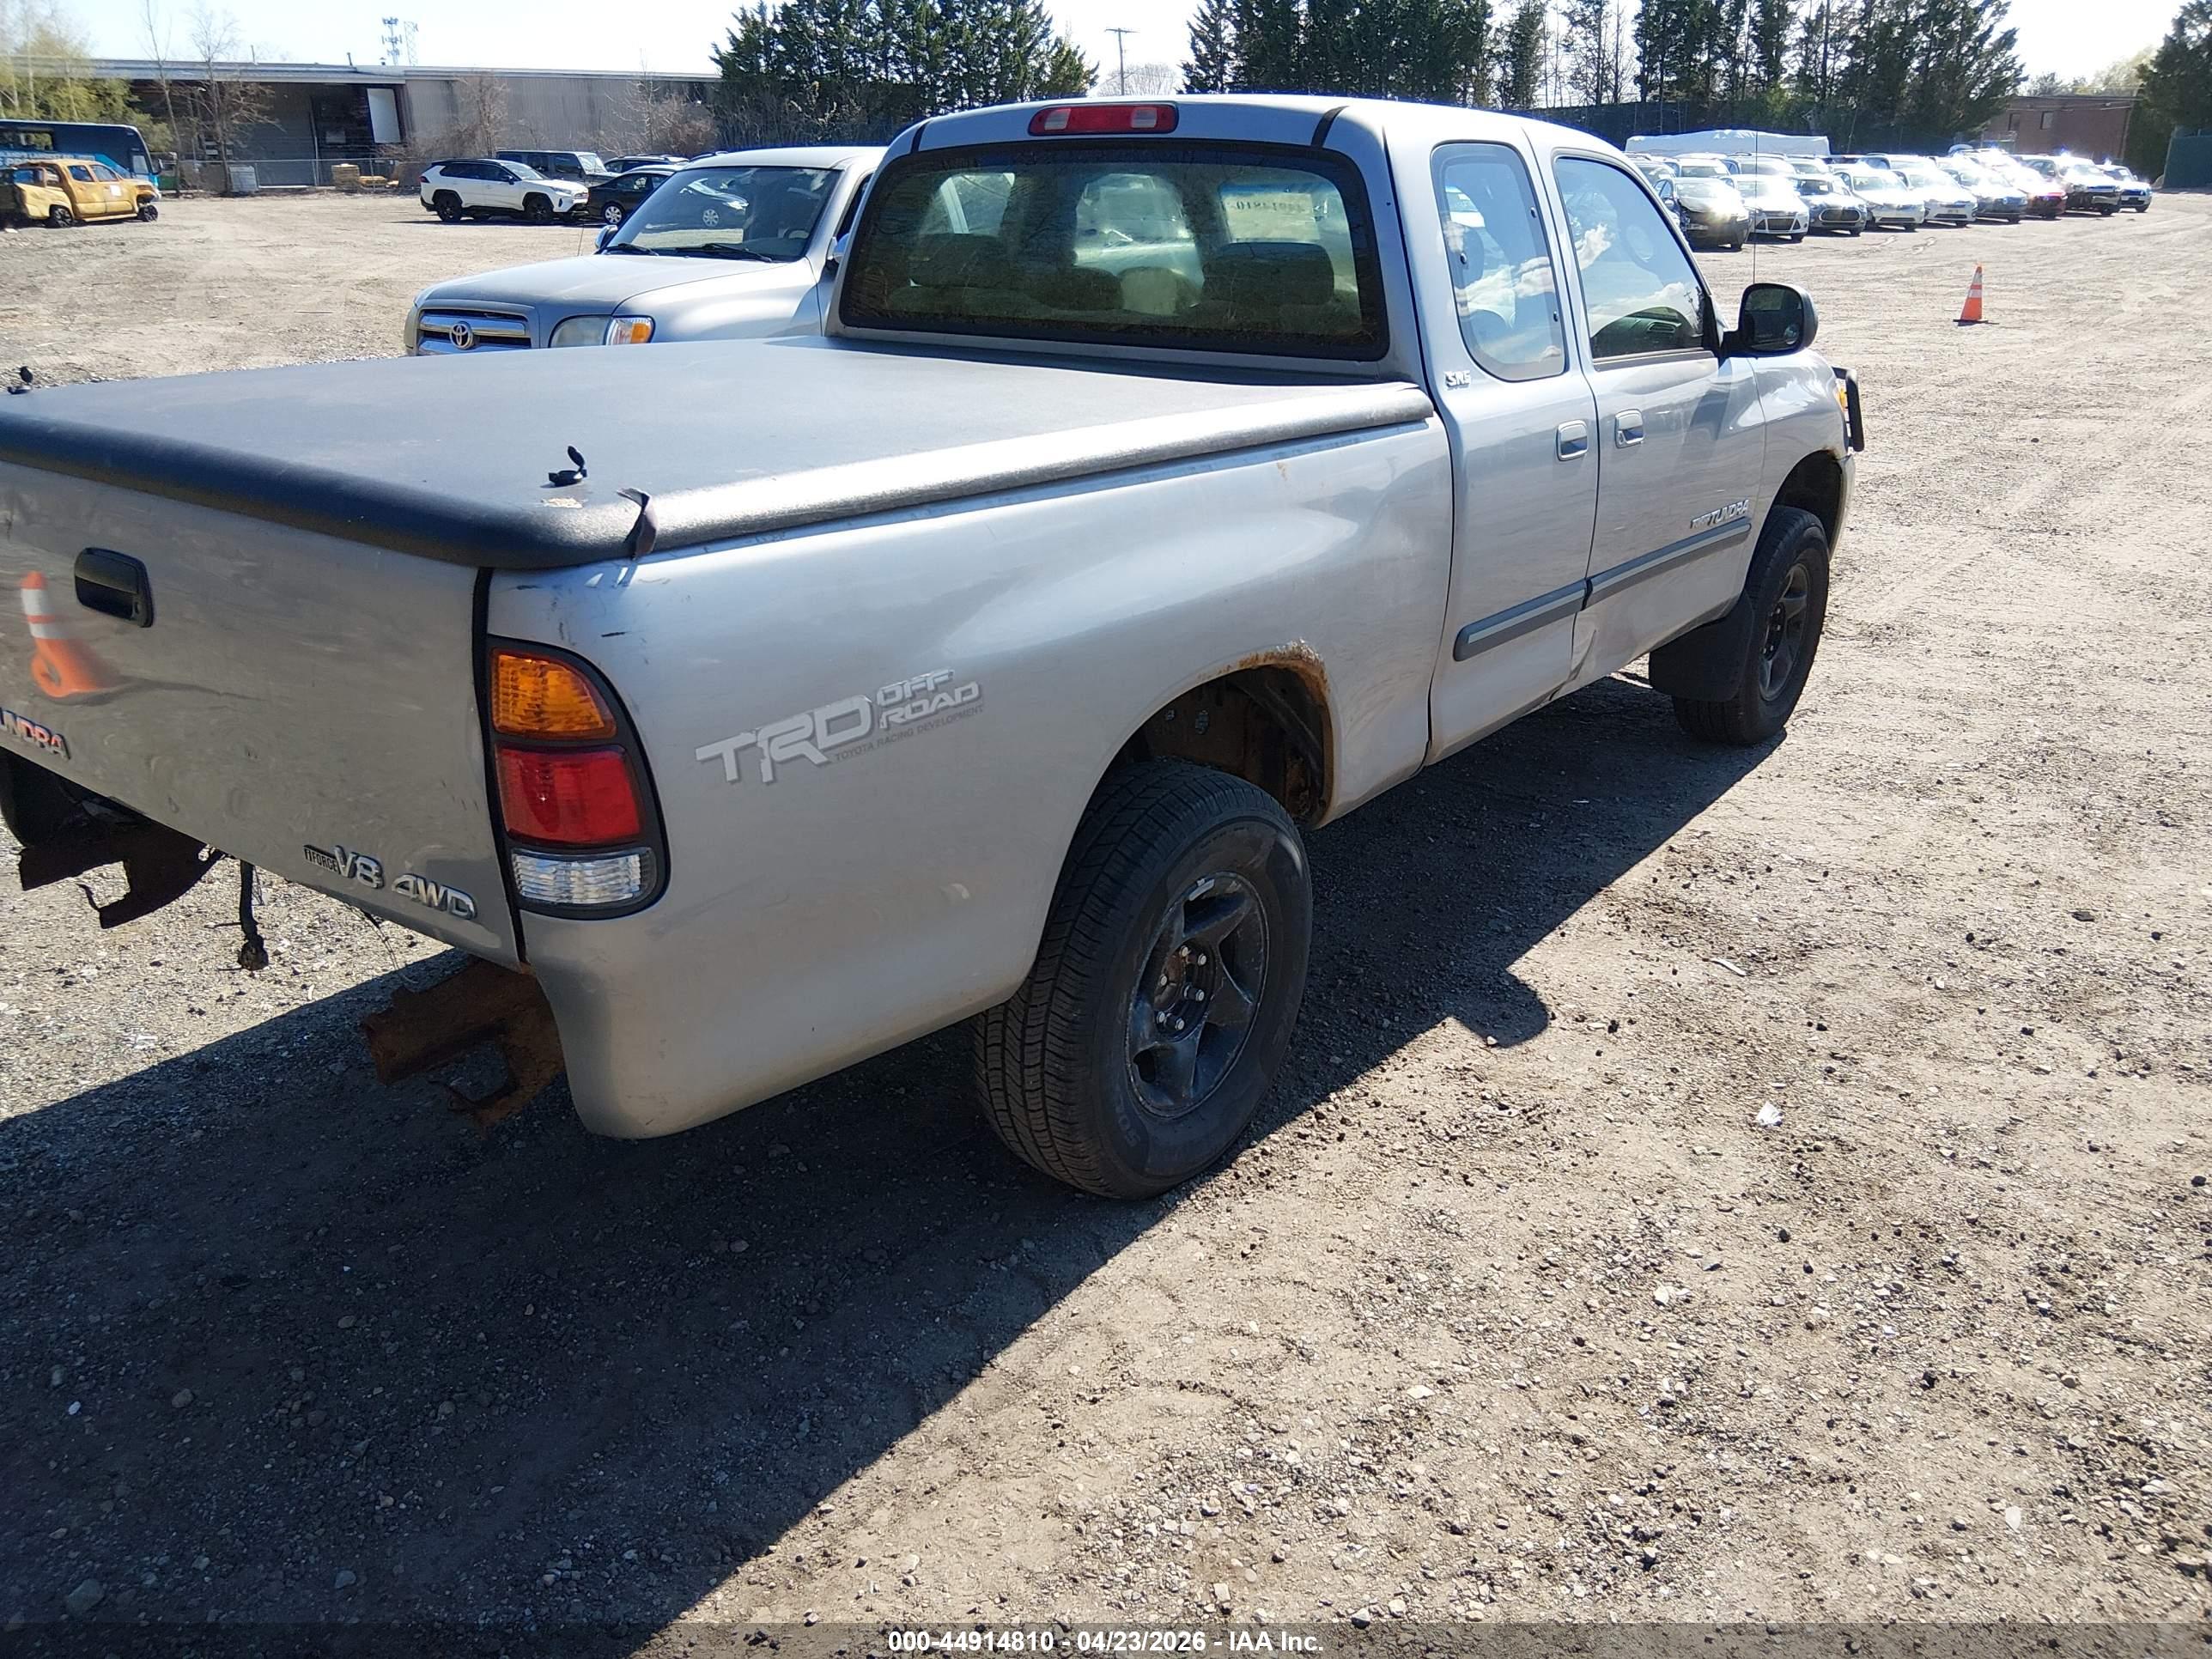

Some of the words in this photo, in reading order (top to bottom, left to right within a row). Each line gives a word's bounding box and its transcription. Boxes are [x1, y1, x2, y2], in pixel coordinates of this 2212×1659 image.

[1710, 499, 1749, 524] TUNDRA
[876, 669, 955, 707] OFF
[878, 681, 981, 729] ROAD
[0, 709, 70, 761] NDRA
[695, 694, 872, 784] TRD
[836, 742, 874, 761] TOYOTA
[877, 728, 915, 749] RACING
[917, 706, 984, 733] DEVELOPMENT
[334, 845, 385, 889] V8
[392, 873, 477, 920] 4WD
